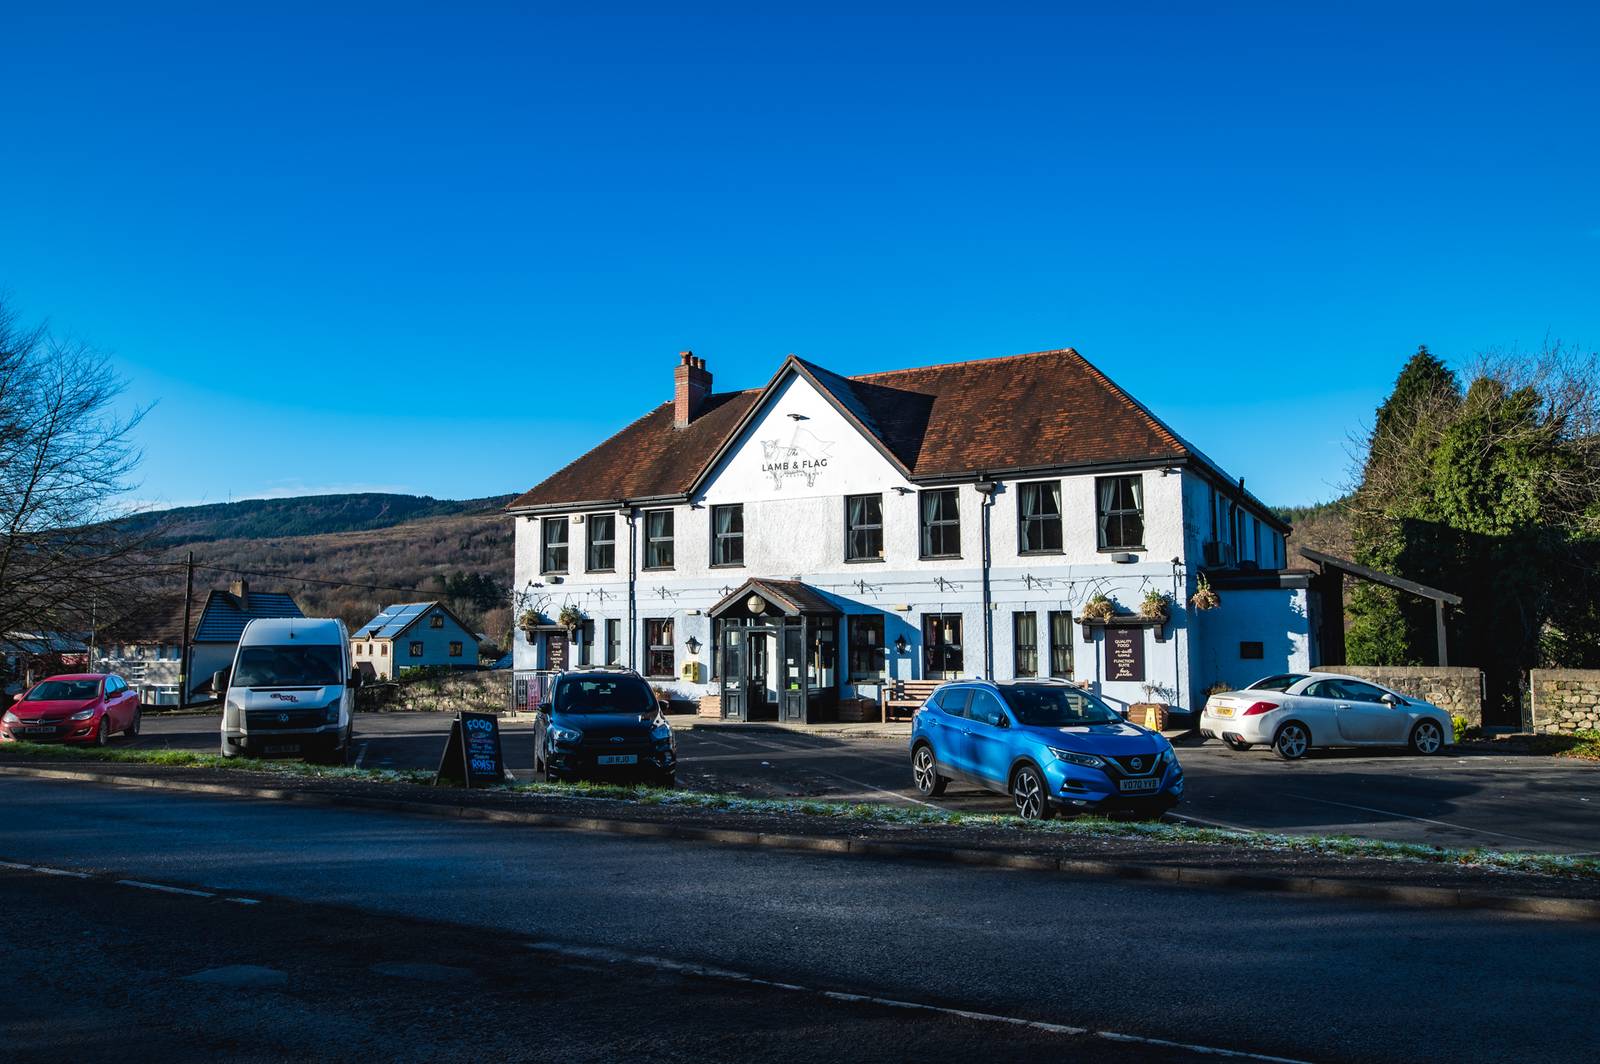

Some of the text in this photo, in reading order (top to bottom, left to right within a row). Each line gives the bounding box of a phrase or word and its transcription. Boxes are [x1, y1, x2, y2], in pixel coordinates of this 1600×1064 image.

[762, 458, 828, 472] LAMB & FLAG
[466, 719, 492, 731] FOOD
[472, 759, 496, 770] ROAST
